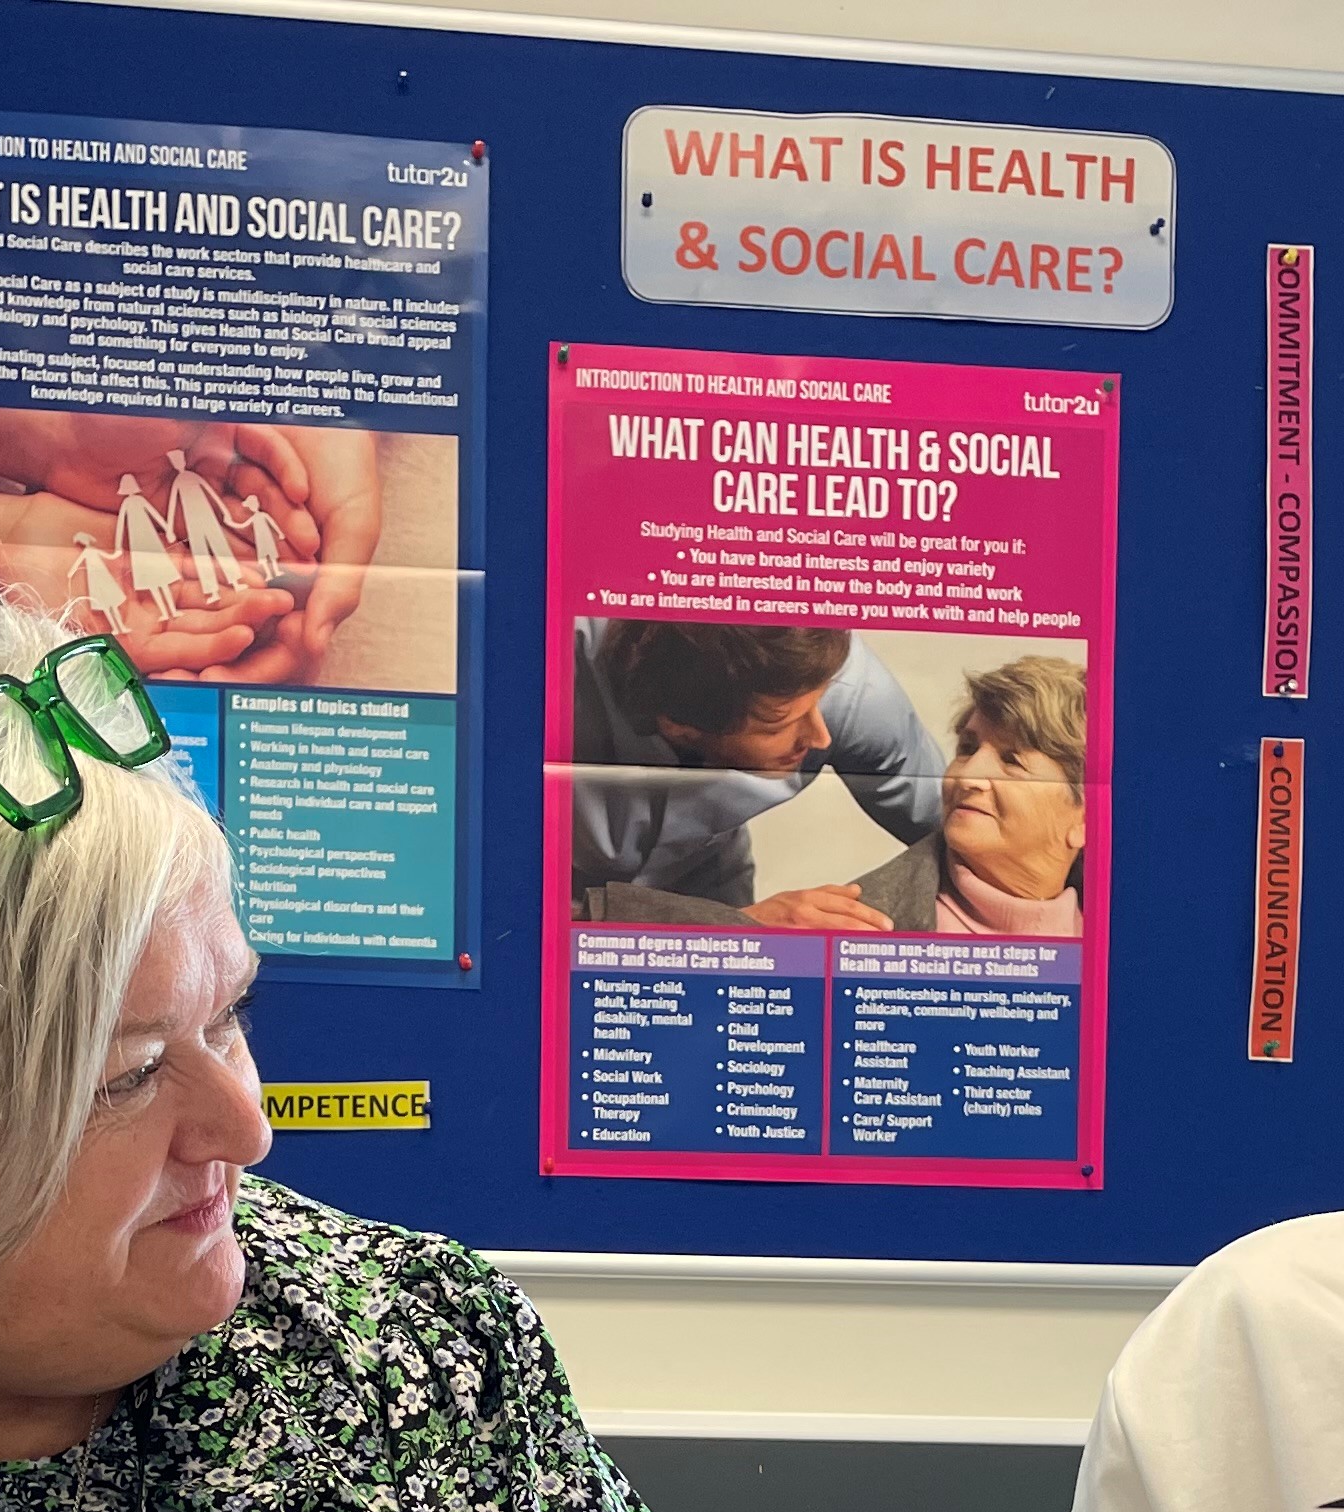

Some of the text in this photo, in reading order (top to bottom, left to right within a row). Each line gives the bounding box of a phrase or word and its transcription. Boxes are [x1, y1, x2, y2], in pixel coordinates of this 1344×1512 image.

[30, 138, 49, 159] TO
[52, 140, 111, 162] HEALTH
[114, 143, 147, 164] AND
[150, 145, 203, 168] SOCIAL
[206, 149, 248, 170] CARE
[664, 129, 1135, 203] WHAT IS HEALTH
[388, 163, 468, 187] tutor2u
[11, 183, 40, 224] IS
[48, 186, 167, 231] HEALTH
[176, 193, 240, 235] AND
[248, 198, 356, 243] SOCIAL
[362, 207, 462, 250] CARE?
[7, 234, 48, 250] Social
[51, 237, 82, 252] Care
[84, 240, 148, 257] describes
[152, 244, 173, 258] the
[176, 247, 210, 260] work
[213, 250, 261, 263] sectors
[264, 251, 290, 265] that
[293, 254, 342, 268] provide
[344, 255, 413, 272] healthcare
[415, 257, 441, 274] and
[674, 221, 1124, 294] & SOCIAL CARE?
[124, 261, 255, 281] social care services.
[1277, 248, 1301, 464] COMMITMENT
[576, 369, 891, 403] INTRODUCTION TO HEALTH AND SOCIAL CARE
[1024, 393, 1100, 415] tutor2u
[609, 415, 1060, 478] WHAT CAN HEALTH & SOCIAL
[713, 470, 957, 521] CARE LEAD TO?
[641, 521, 1026, 554] Studying Health and Social Care will be great for you if:
[691, 548, 995, 580] You have broad interests and enjoy variety
[661, 570, 1022, 601] You are interested in how the body and mind work
[1274, 492, 1301, 693] COMPASSION
[601, 590, 1081, 627] You are interested in careers where you work with and help people
[232, 695, 409, 718] Examples of topics studied
[1261, 767, 1292, 1032] COMMUNICATION
[578, 934, 760, 953] Common degree subjects for
[578, 951, 774, 970] Health and Social Care students
[593, 1048, 652, 1064] Midwifery
[728, 1039, 805, 1054] Development
[593, 1070, 662, 1083] Social Work
[965, 1065, 1070, 1080] Teaching Assistant
[728, 1082, 794, 1097] Psychology
[261, 1094, 425, 1118] MPETENCE
[727, 1103, 797, 1119] Criminology
[593, 1128, 651, 1141] Education
